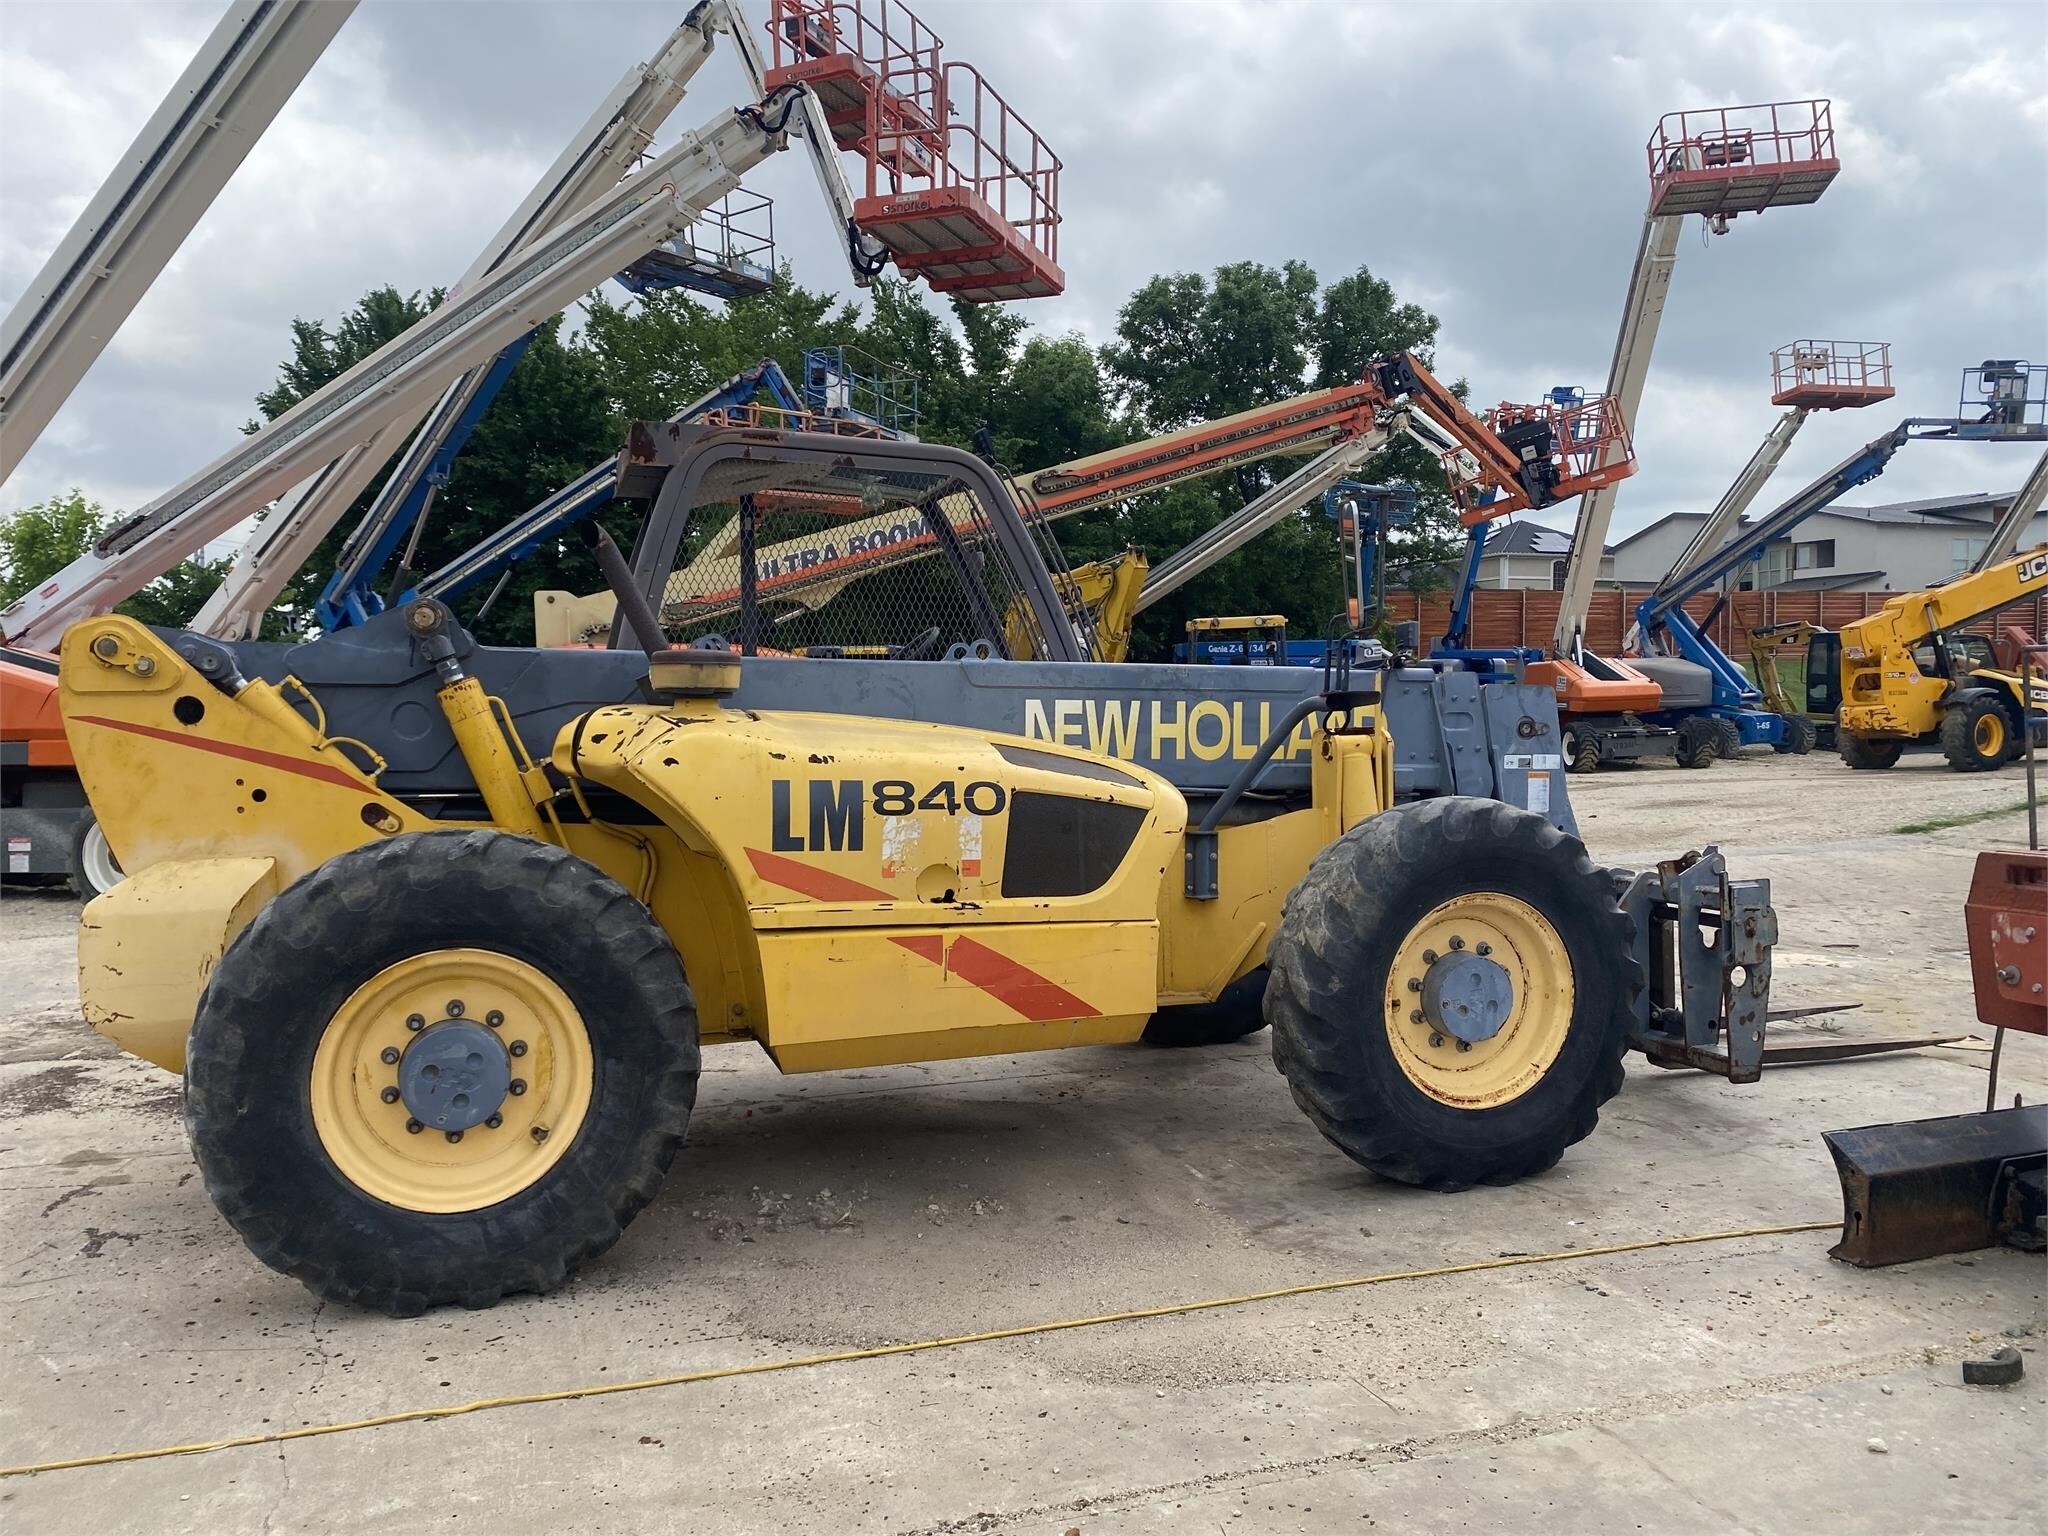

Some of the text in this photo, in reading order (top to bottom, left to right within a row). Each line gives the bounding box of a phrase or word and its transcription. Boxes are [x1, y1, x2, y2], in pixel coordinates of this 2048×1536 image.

[890, 199, 931, 214] snorkel
[754, 516, 934, 581] ULTRA BOOM
[2017, 555, 2048, 582] JC
[1208, 644, 1264, 653] Genie Z-6/34
[1025, 699, 1388, 761] NEW HOLLA
